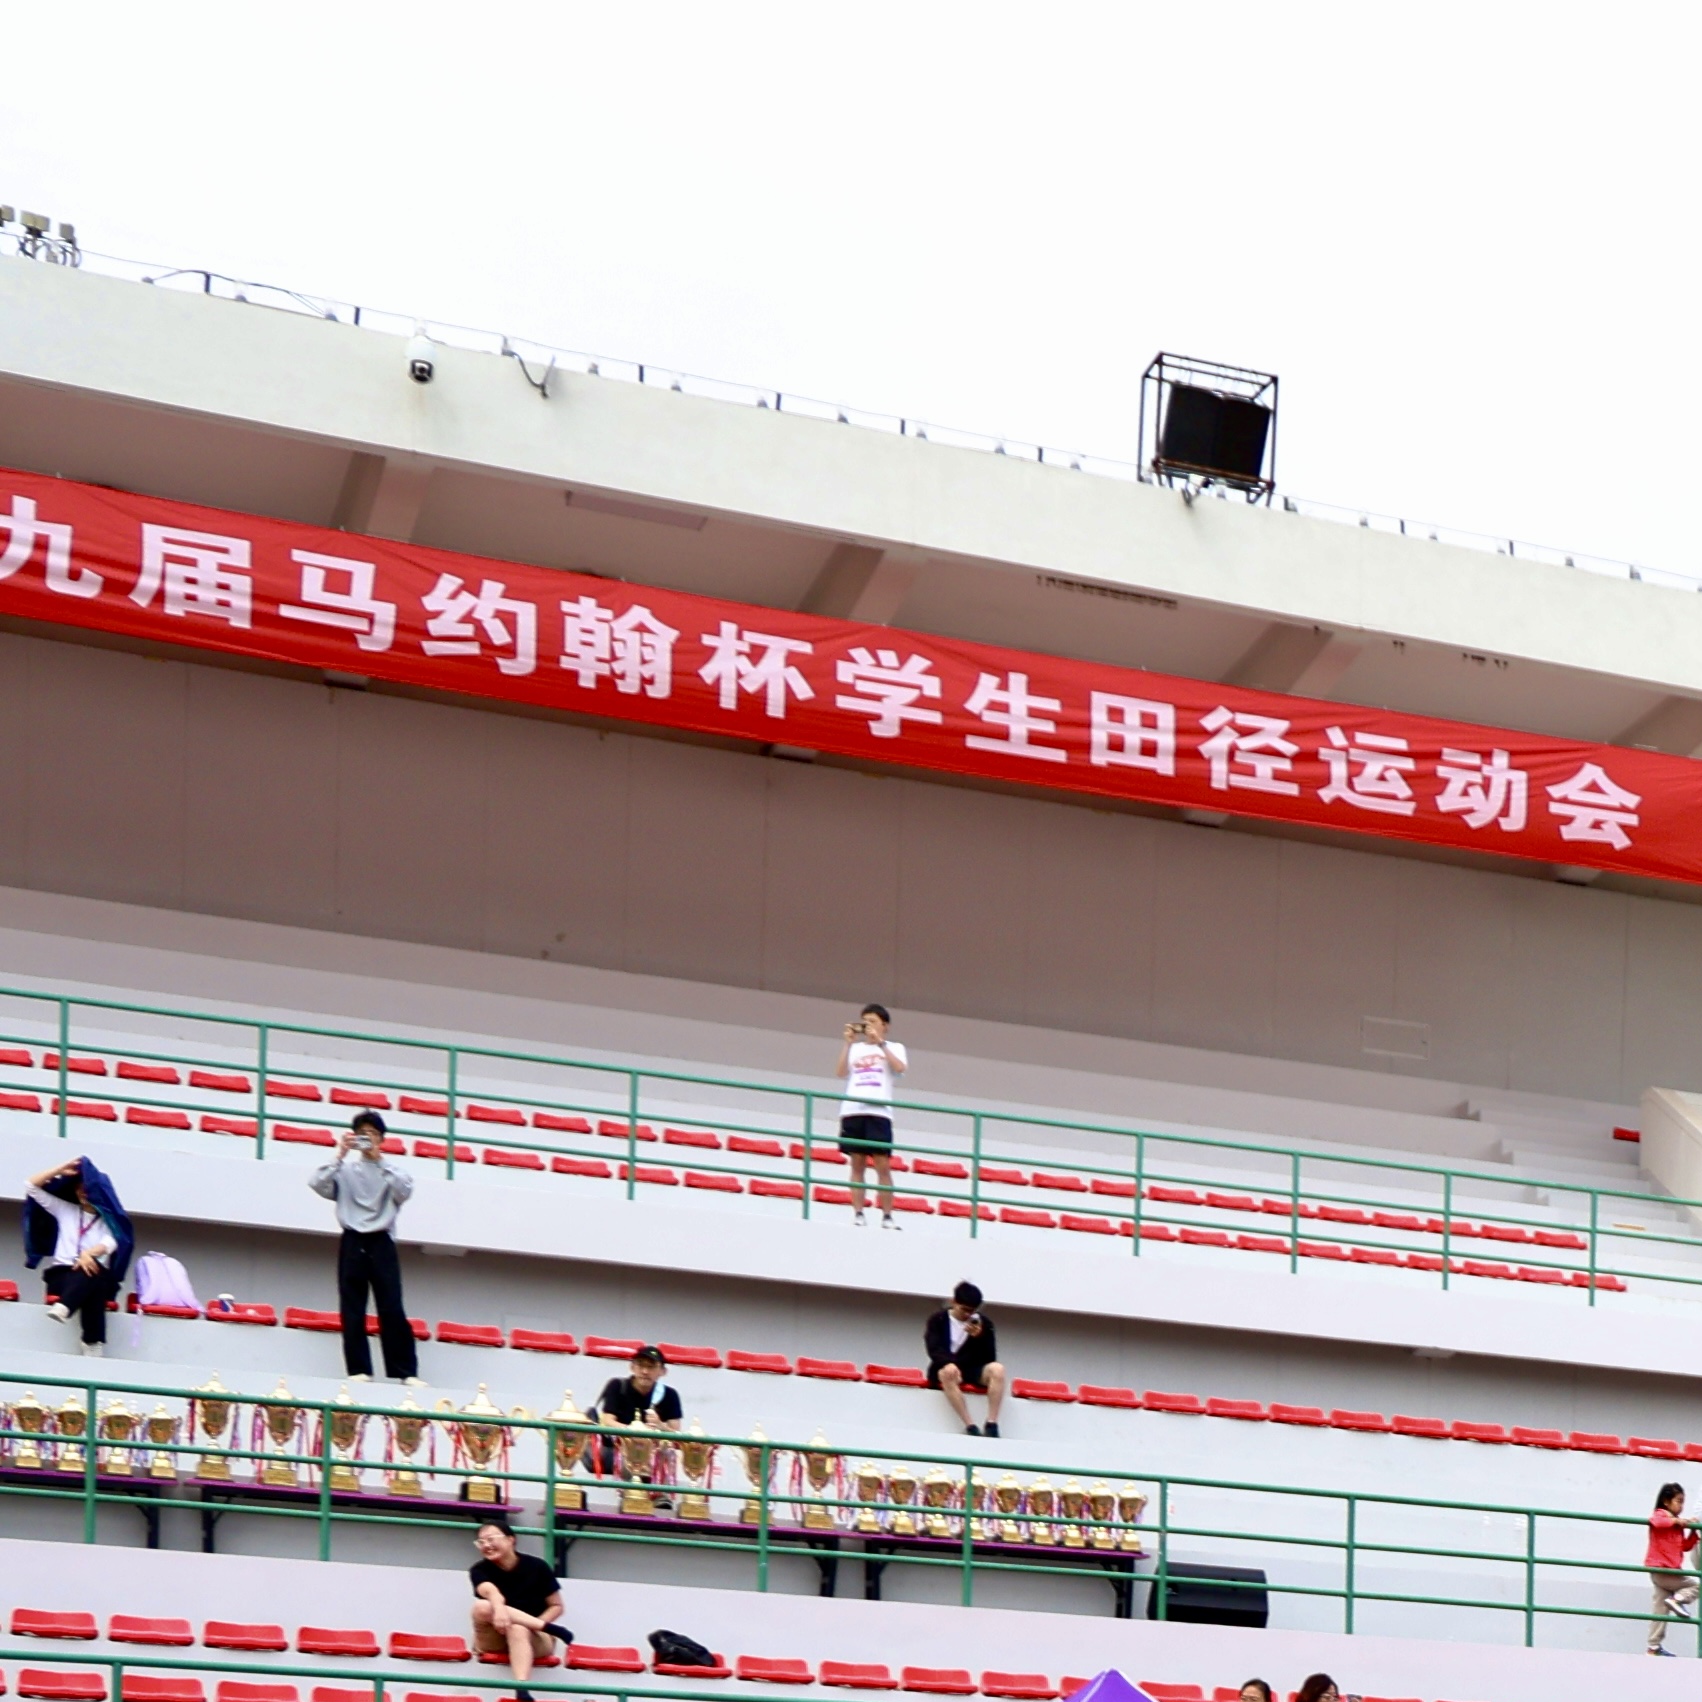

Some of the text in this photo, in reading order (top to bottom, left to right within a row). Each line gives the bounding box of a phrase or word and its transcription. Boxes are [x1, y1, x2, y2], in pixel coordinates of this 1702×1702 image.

[0, 494, 1643, 851] 九届马约翰杯学生田径运动会
